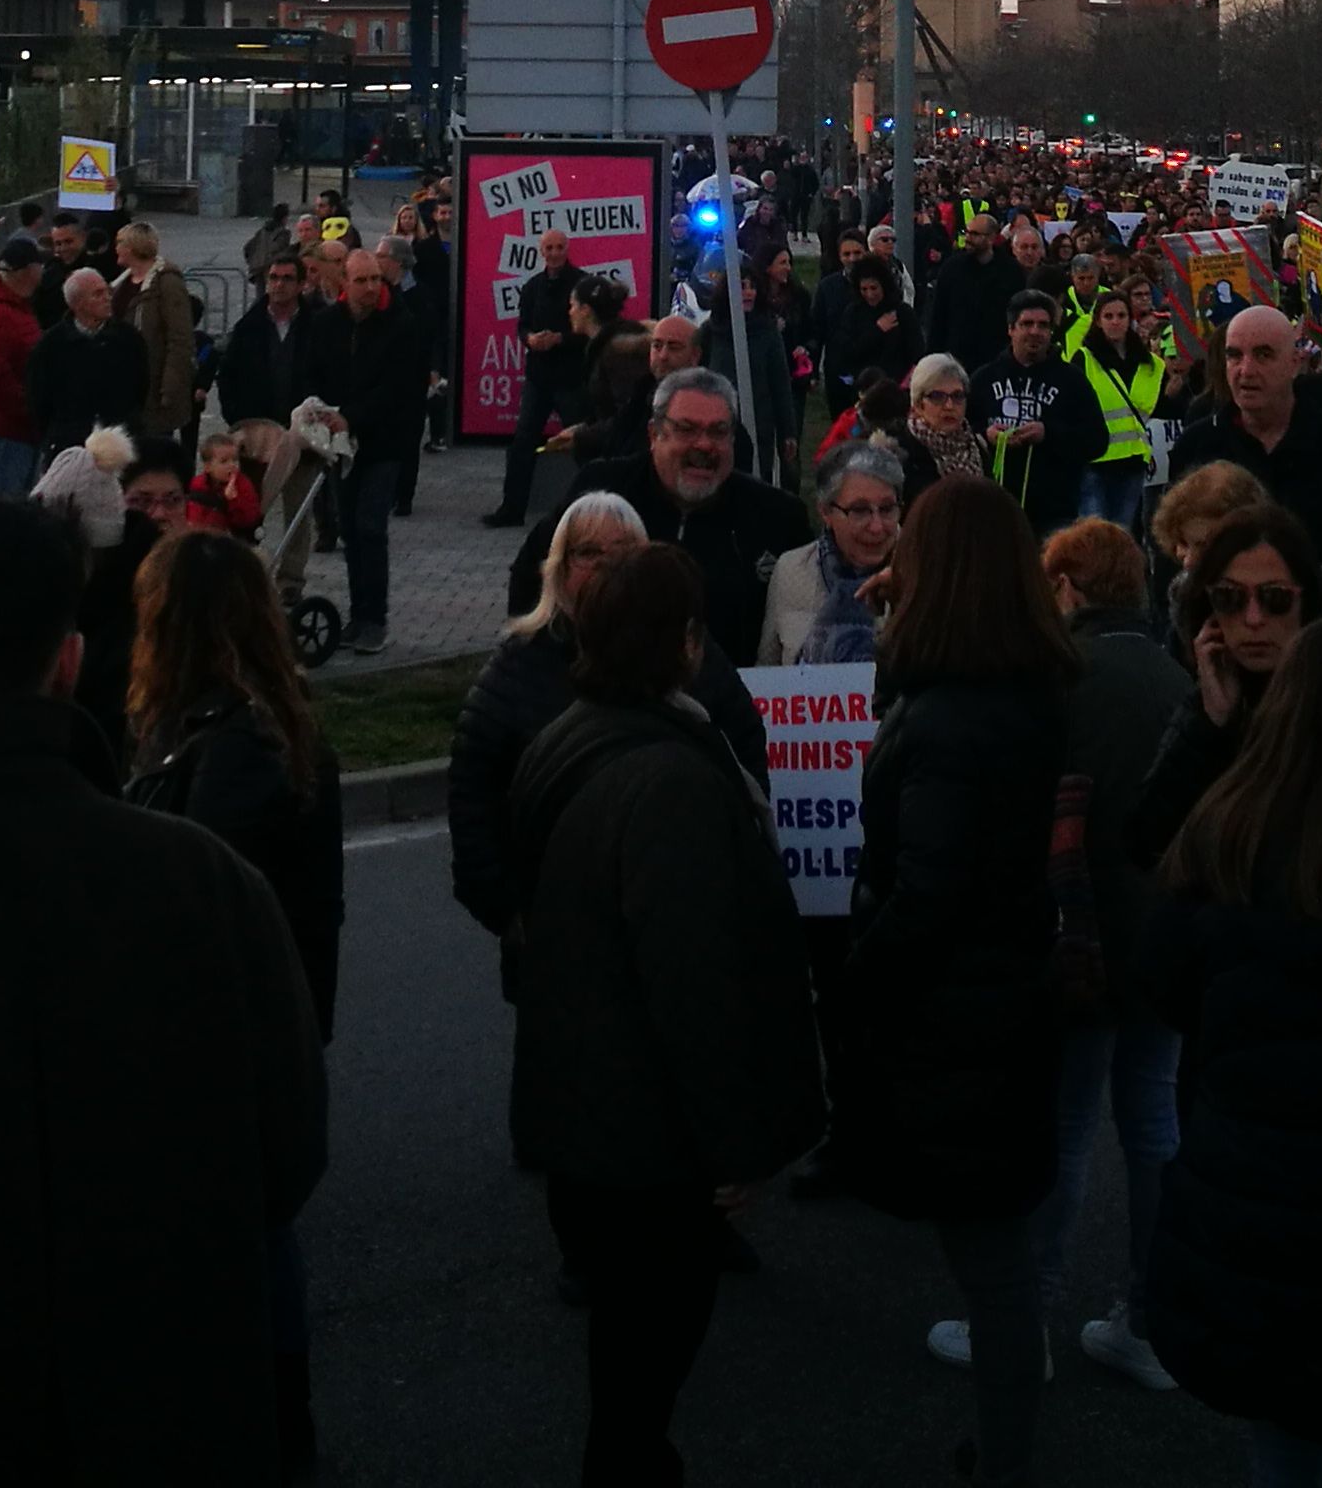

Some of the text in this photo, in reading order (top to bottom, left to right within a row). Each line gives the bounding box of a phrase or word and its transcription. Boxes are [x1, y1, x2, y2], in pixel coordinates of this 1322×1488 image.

[490, 171, 547, 208] SI NO
[531, 204, 640, 235] ET VEUEN.
[509, 244, 538, 271] NO
[777, 798, 867, 829] RESP
